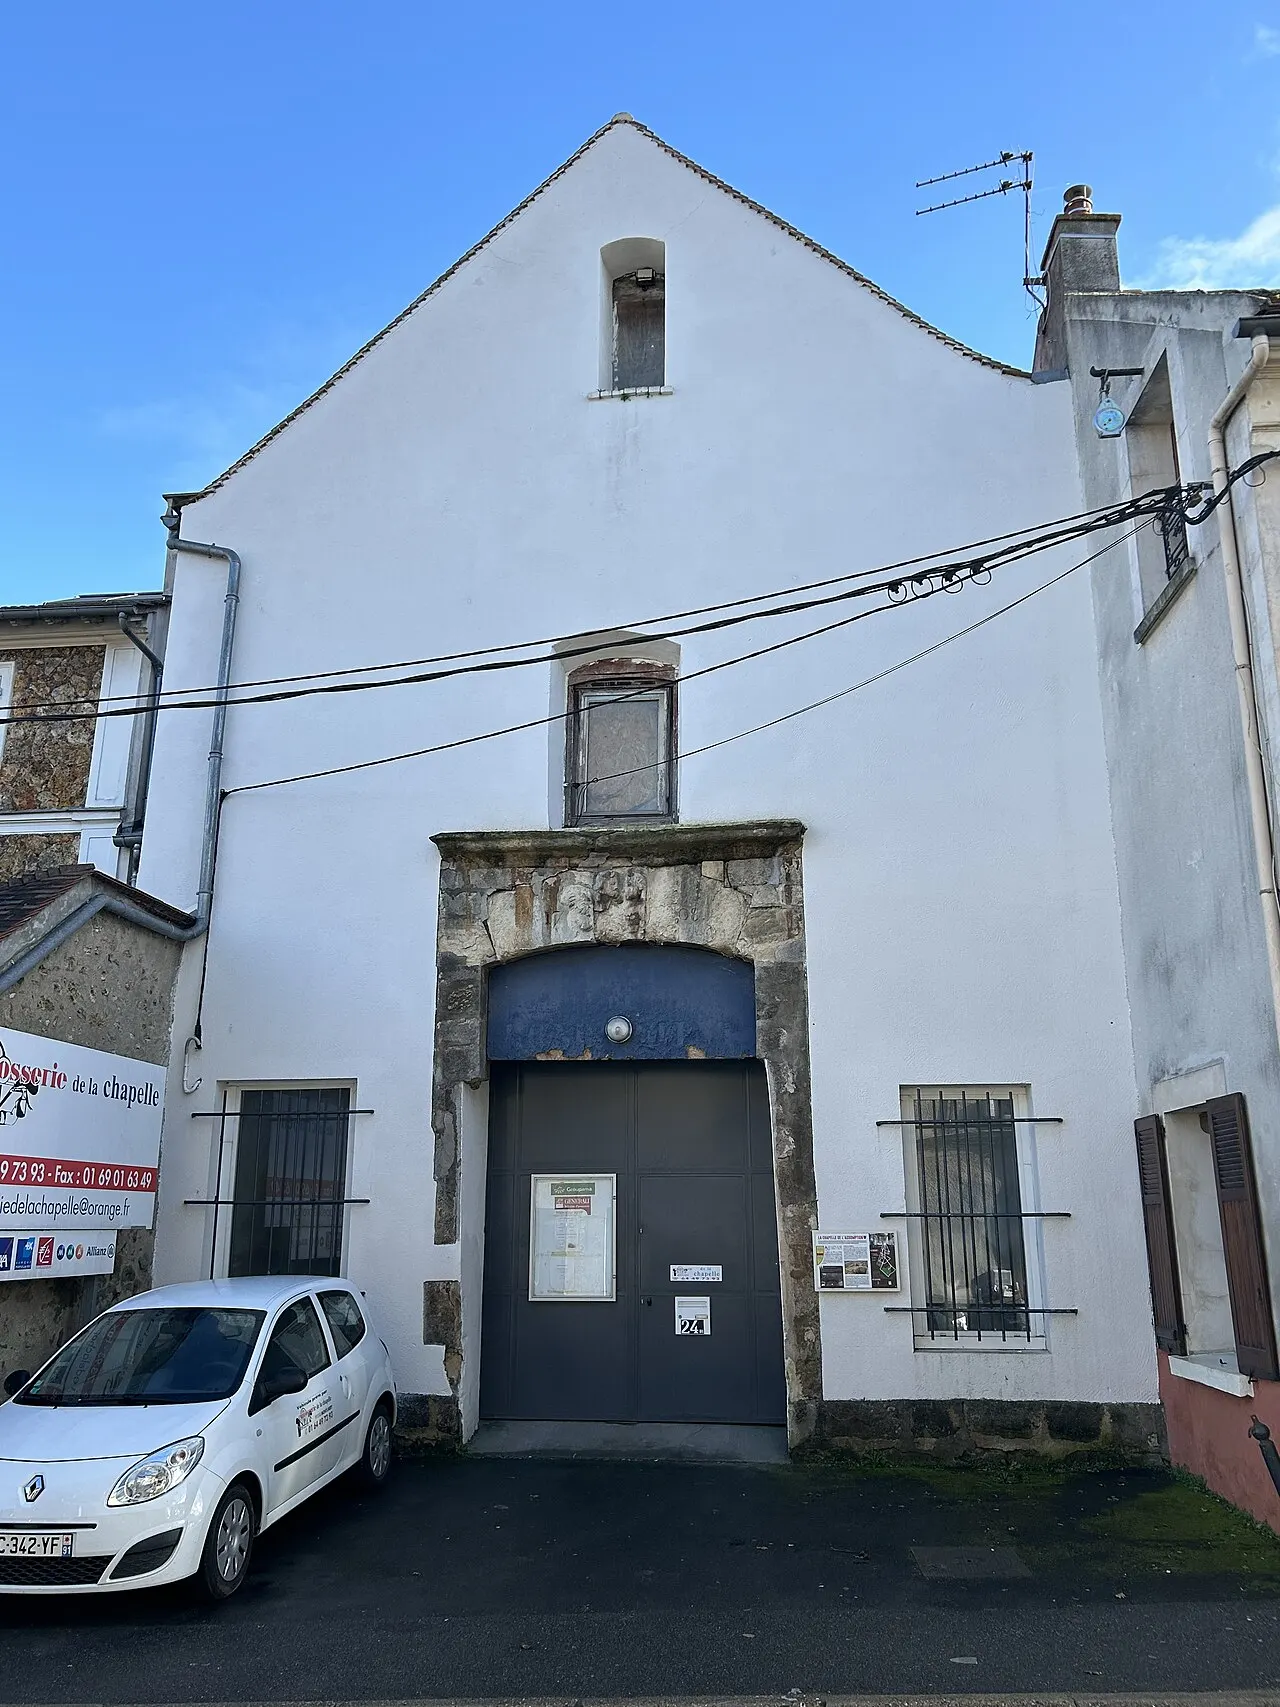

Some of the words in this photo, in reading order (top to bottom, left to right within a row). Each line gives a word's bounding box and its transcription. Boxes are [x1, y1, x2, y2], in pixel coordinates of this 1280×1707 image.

[0, 1060, 68, 1089] osserie
[73, 1075, 85, 1093] de
[88, 1078, 97, 1095] la
[104, 1074, 159, 1109] chapelle
[11, 1162, 27, 1181] 73
[31, 1163, 44, 1182] 93
[55, 1165, 73, 1184] Fax
[83, 1167, 95, 1184] 01
[99, 1169, 111, 1186] 69
[114, 1170, 124, 1186] 01
[127, 1171, 138, 1187] 63
[140, 1172, 152, 1188] 49
[86, 1246, 106, 1256] Allianz
[682, 1320, 698, 1334] 24
[63, 1546, 70, 1554] 91
